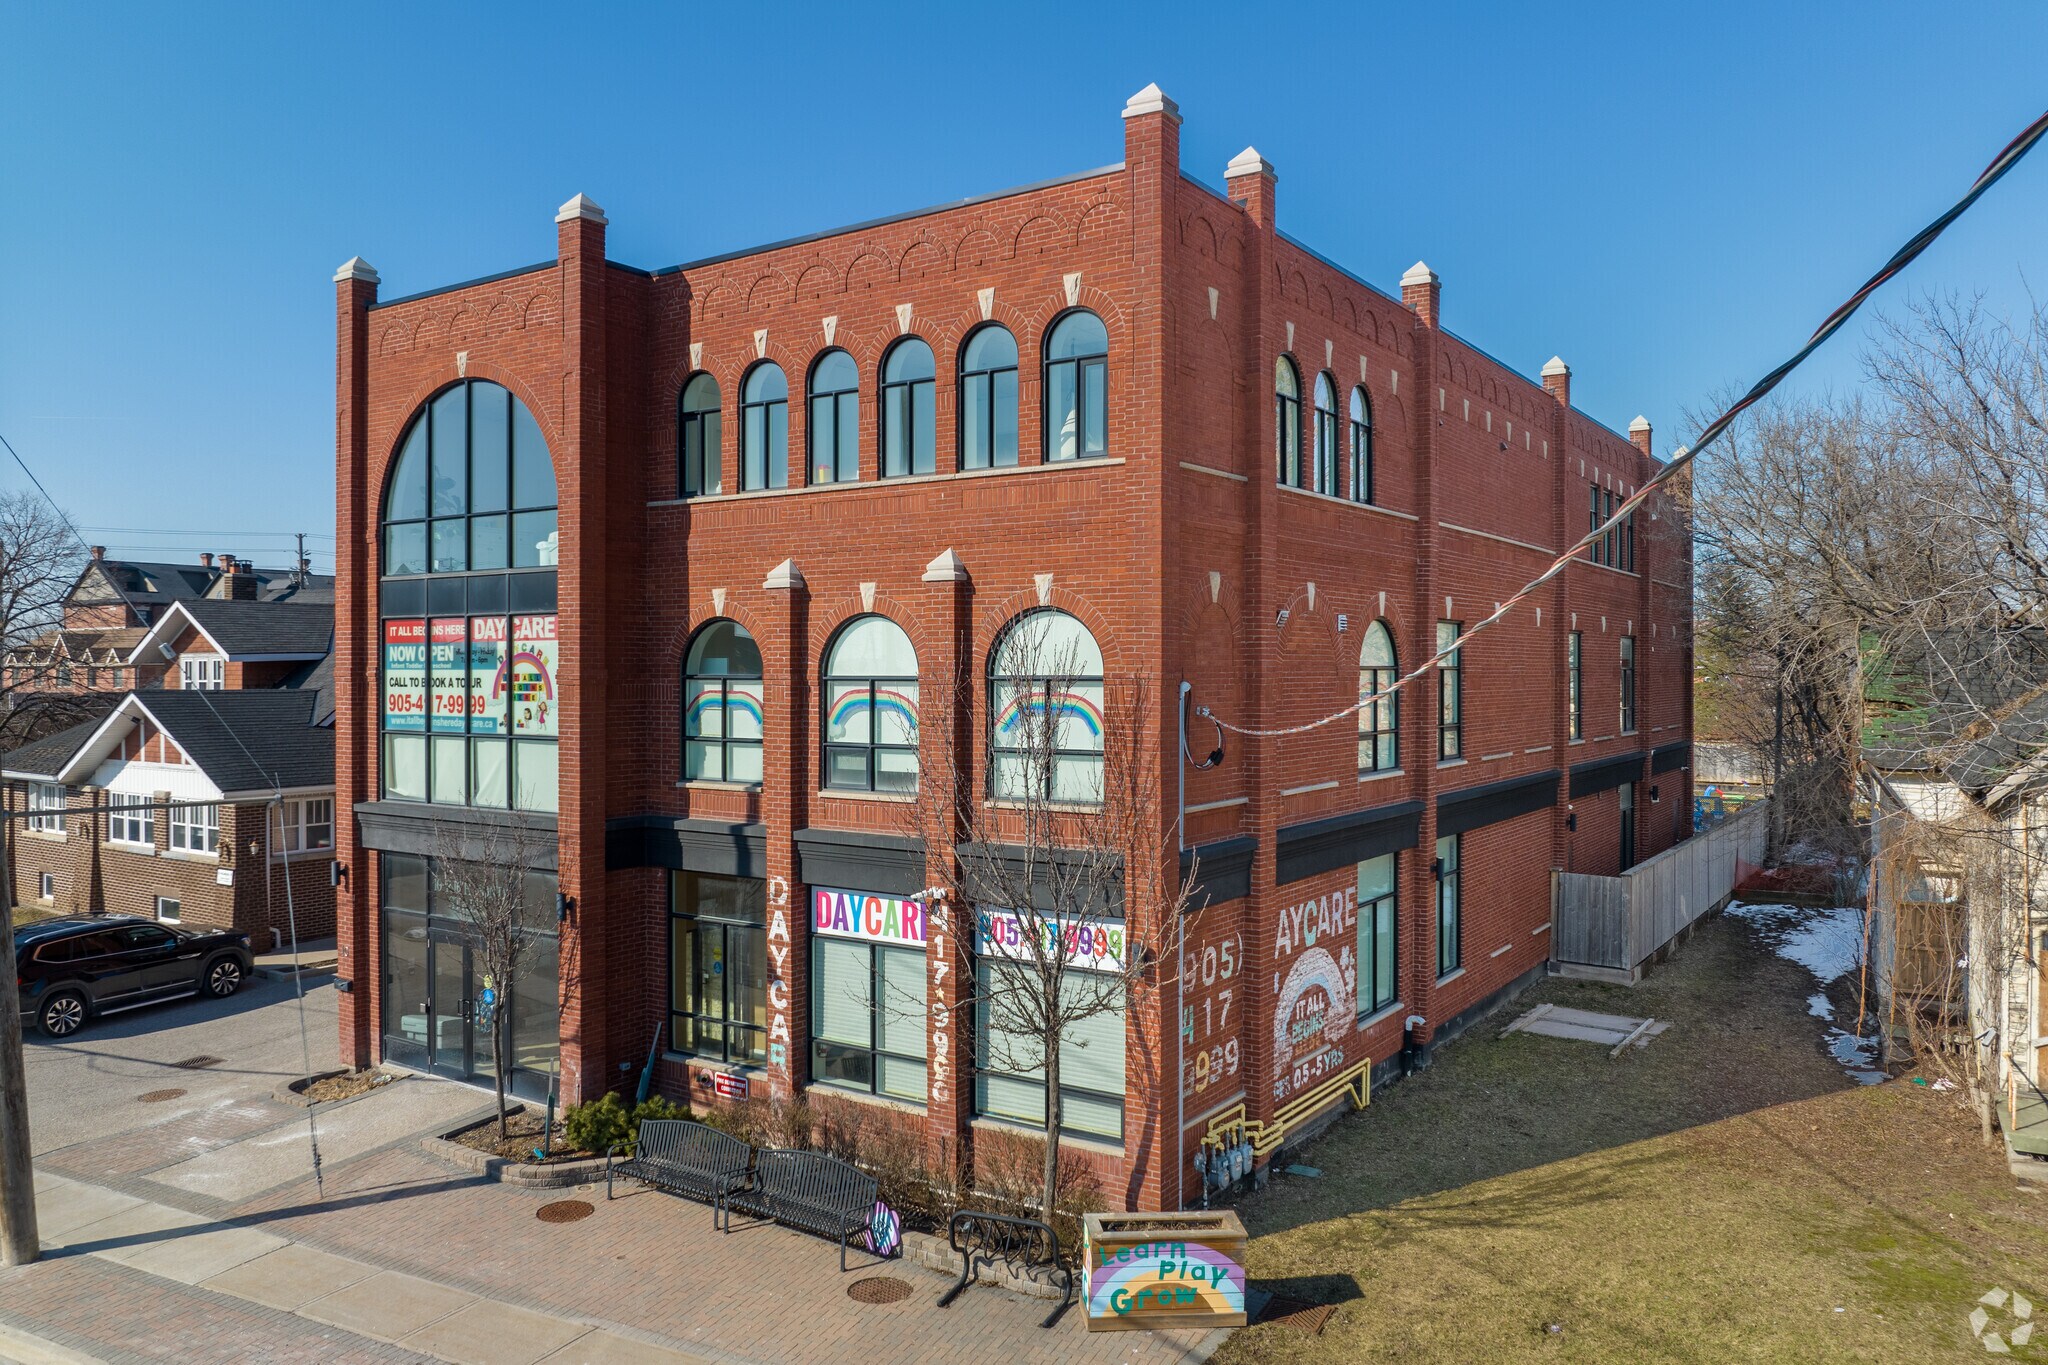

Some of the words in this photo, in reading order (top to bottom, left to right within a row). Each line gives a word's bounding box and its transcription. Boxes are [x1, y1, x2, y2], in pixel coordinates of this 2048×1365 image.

[389, 626, 397, 637] IT
[398, 625, 412, 636] ALL
[445, 624, 465, 635] HERE
[389, 645, 416, 662] NOW
[418, 645, 454, 662] OPEN
[389, 677, 408, 687] CALL
[409, 677, 419, 687] TO
[448, 677, 454, 688] A
[1183, 989, 1233, 1045] 417
[1296, 999, 1306, 1020] IT
[1307, 992, 1325, 1016] ALL
[1100, 1242, 1186, 1266] Learn
[1111, 1288, 1197, 1315] Grow
